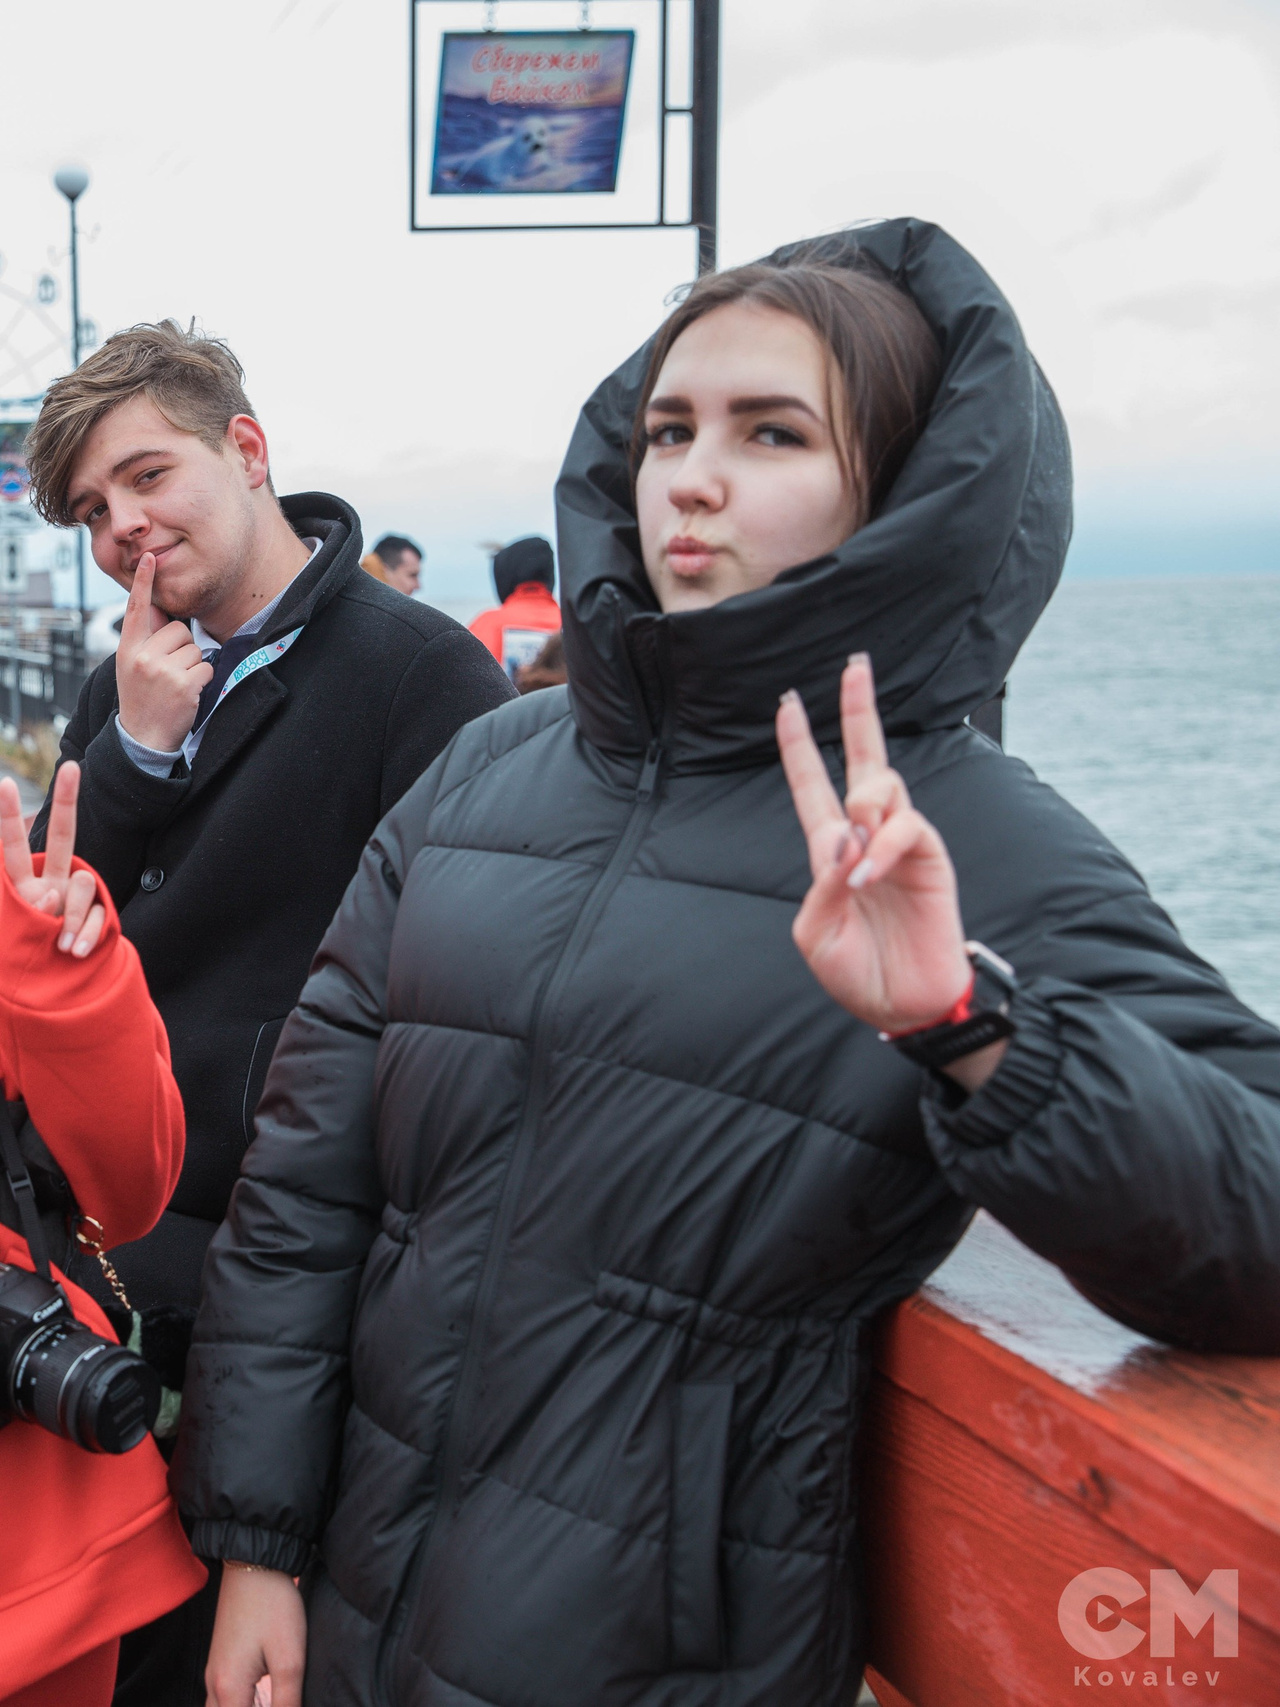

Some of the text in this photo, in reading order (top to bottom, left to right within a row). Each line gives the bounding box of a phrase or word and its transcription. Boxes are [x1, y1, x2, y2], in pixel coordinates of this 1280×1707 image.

[489, 76, 587, 103] Байкал
[235, 655, 270, 682] РОССИЯ
[248, 649, 267, 662] НАШ
[32, 1298, 63, 1323] Canon
